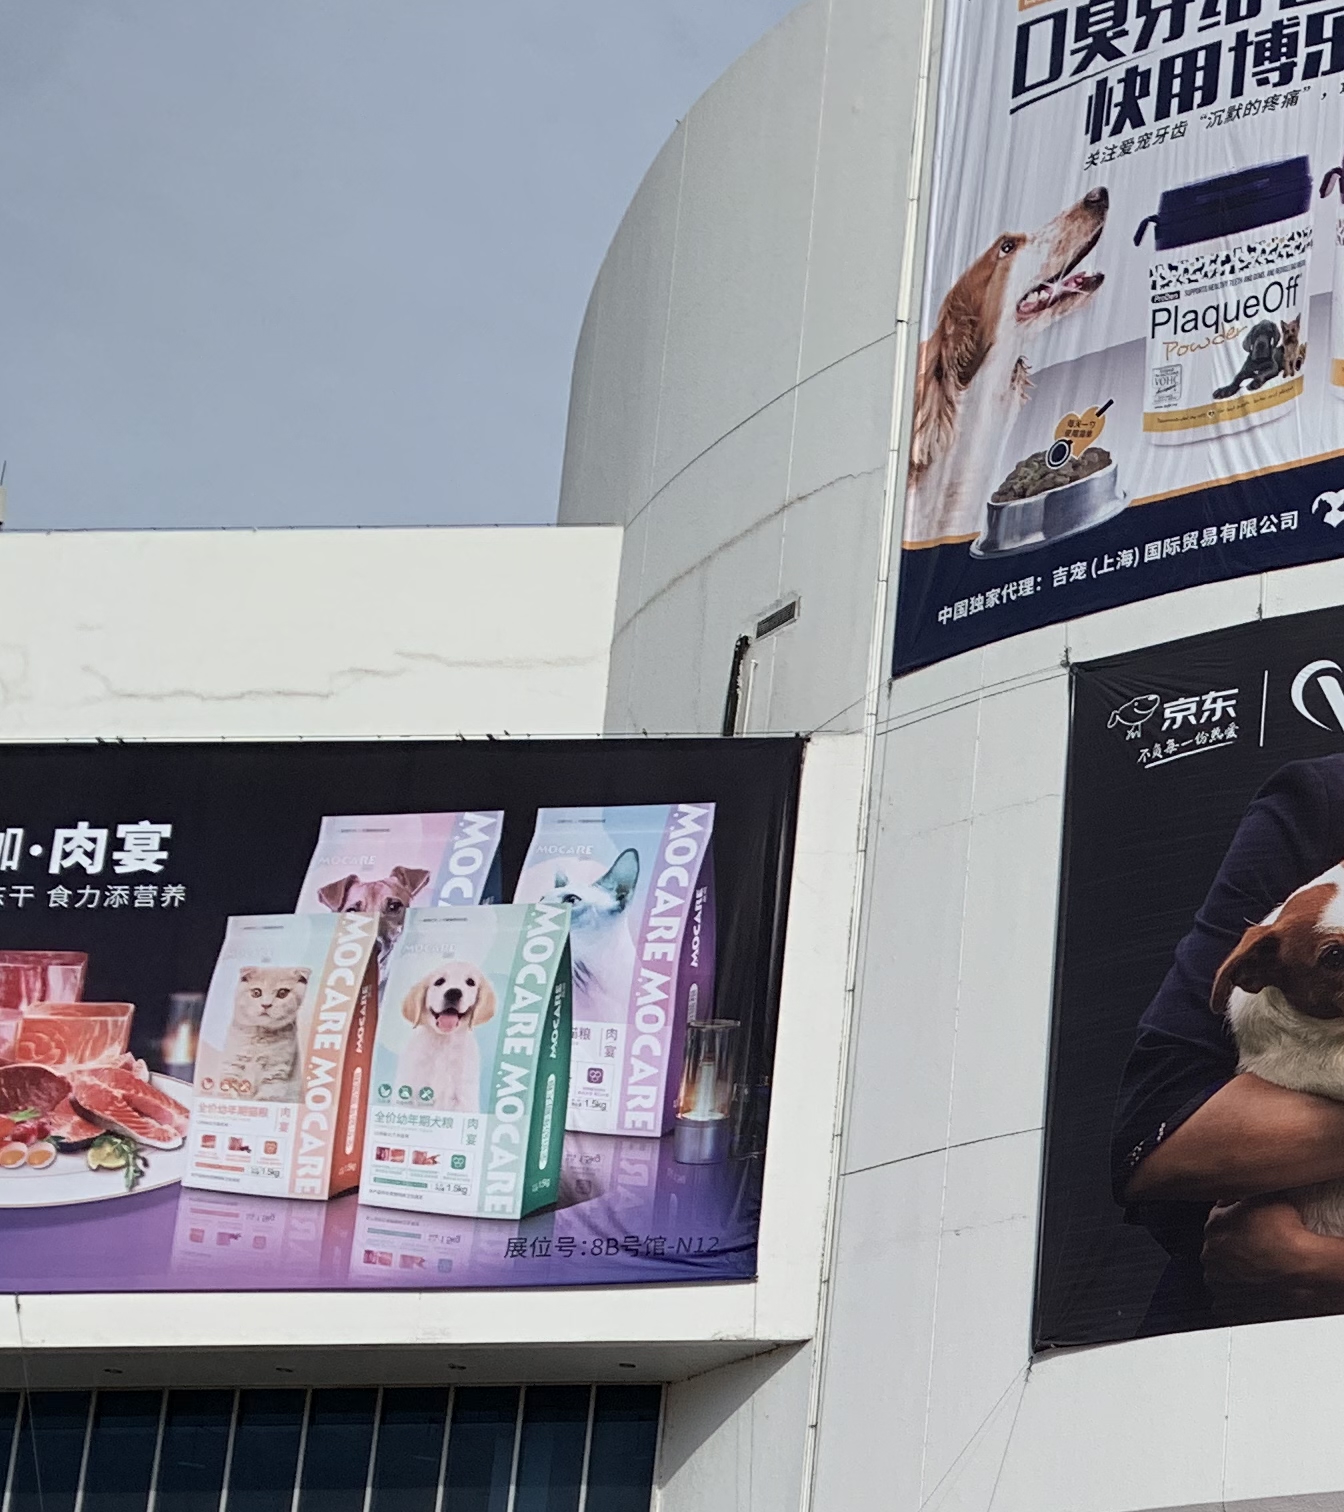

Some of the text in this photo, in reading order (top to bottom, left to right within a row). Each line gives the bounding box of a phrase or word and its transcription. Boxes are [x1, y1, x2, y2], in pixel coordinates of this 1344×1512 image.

[1012, 0, 1335, 99] 口臭牙
[1151, 275, 1302, 339] PlaqueOff
[1163, 323, 1248, 360] Powder
[1161, 688, 1239, 731] 京东
[47, 884, 187, 908] 食力添营养
[439, 811, 499, 907] MOC
[641, 803, 710, 965] MOCARE
[314, 911, 374, 1050] MOCARE
[503, 903, 567, 1056] MOCARE
[604, 1028, 617, 1058] 肉宴
[623, 969, 674, 1134] MOCARE
[296, 1055, 338, 1195] MOCARE
[374, 1111, 454, 1130] 全价幼年期犬粮
[466, 1118, 480, 1146] 肉宴
[484, 1061, 535, 1214] MOCARE
[585, 1099, 607, 1111] 1.5kg
